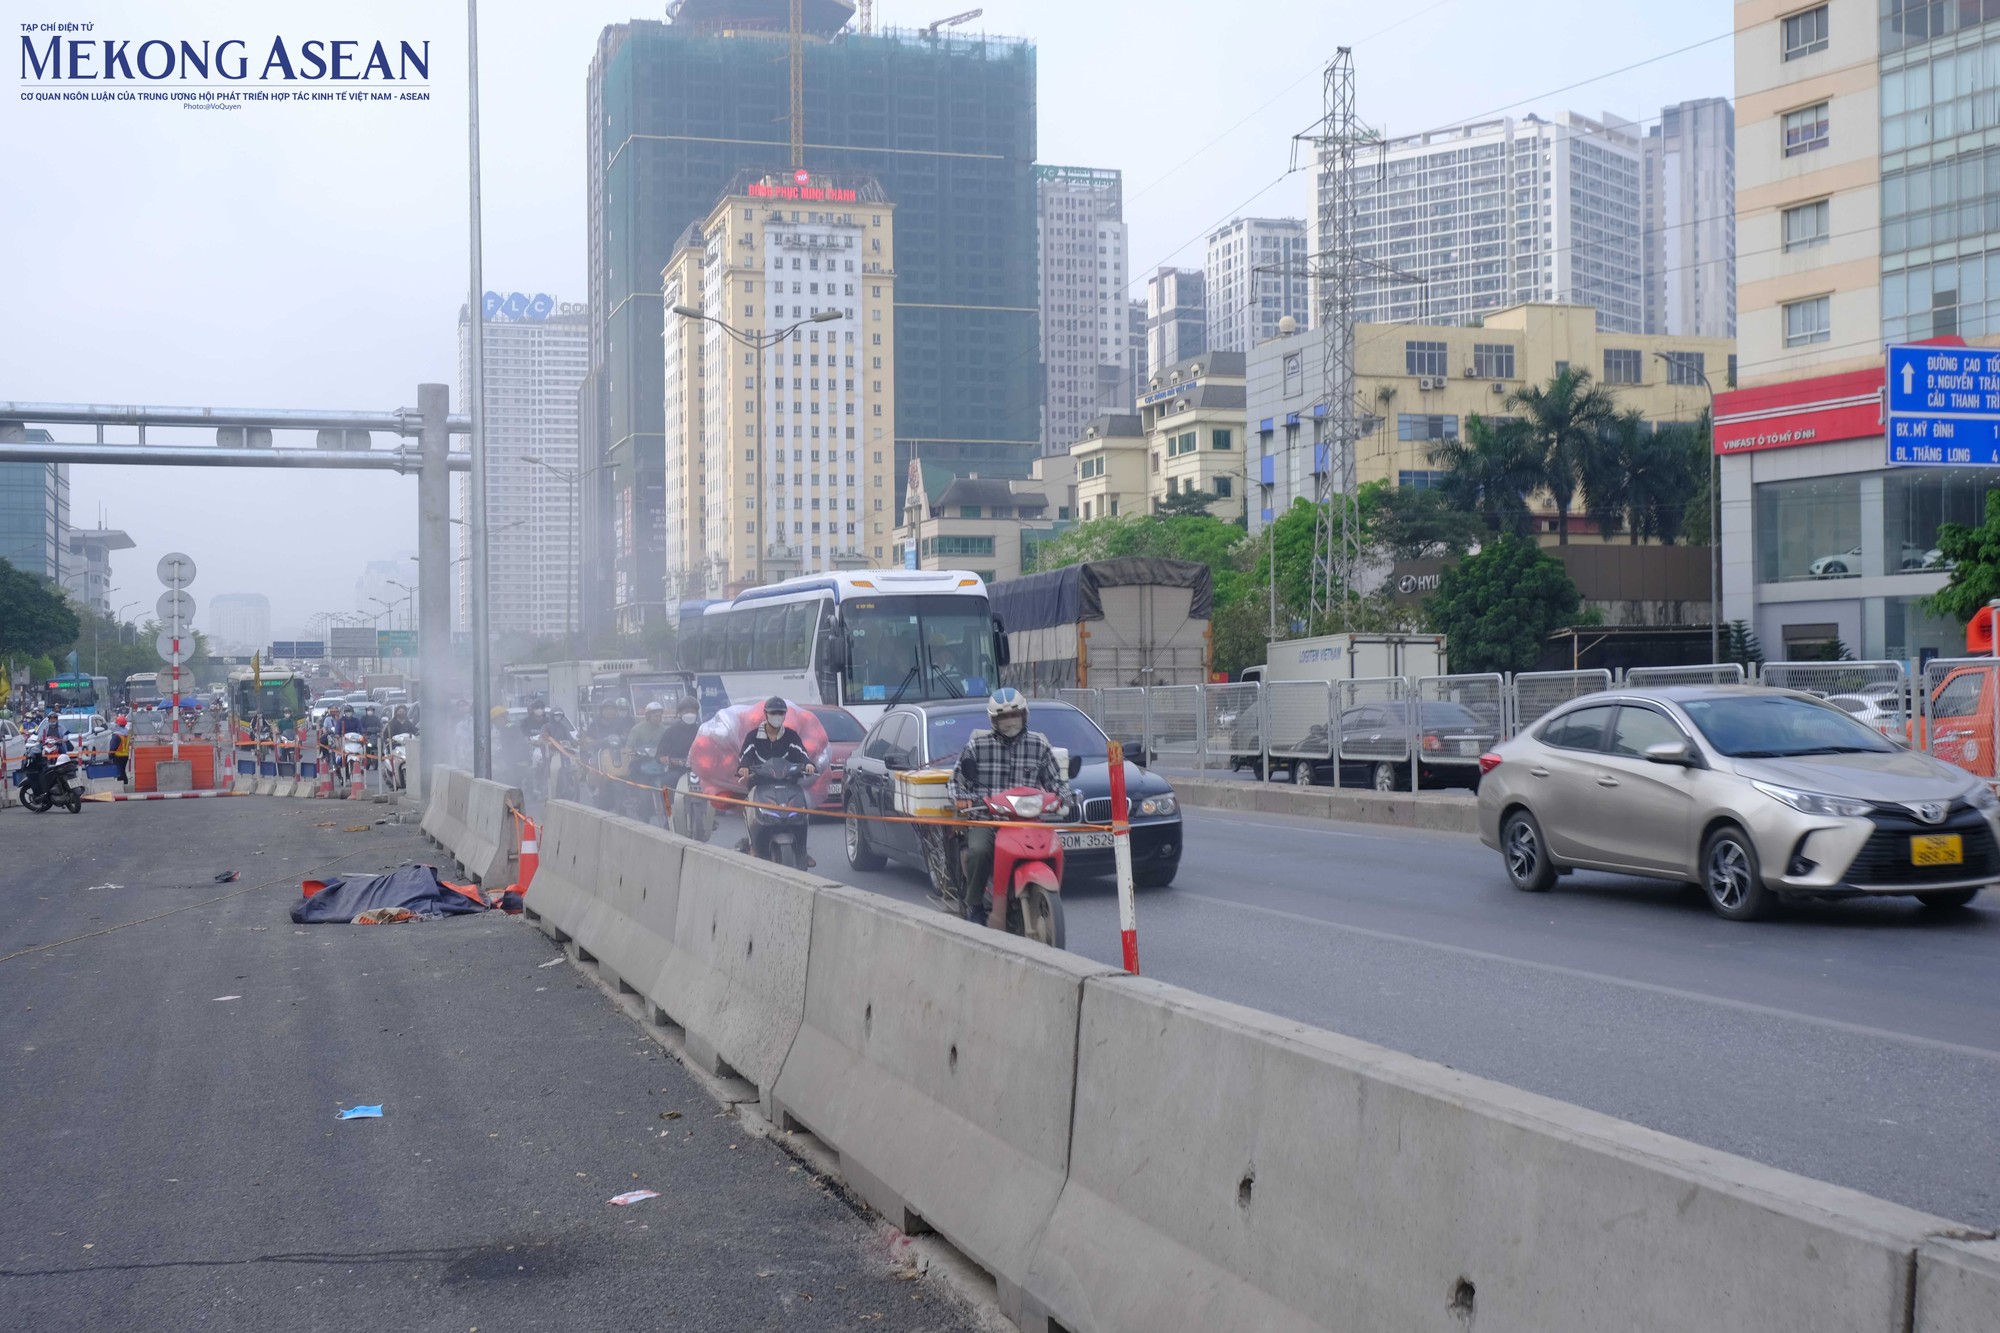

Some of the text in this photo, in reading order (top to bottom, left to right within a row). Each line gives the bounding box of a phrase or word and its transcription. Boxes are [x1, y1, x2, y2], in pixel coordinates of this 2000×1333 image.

[801, 187, 824, 200] MINH
[1927, 352, 1958, 371] ĐƯỜNG
[1963, 358, 1980, 372] CAO
[1979, 375, 2000, 391] TRÃI
[1927, 389, 2000, 409] CẦU THANH TRÌ
[1933, 420, 1954, 438] ĐÌNH
[1723, 436, 1757, 450] VINFAST
[1766, 431, 1779, 444] TÔ
[1947, 447, 1971, 462] LONG
[1991, 449, 1998, 463] 4
[1418, 574, 1441, 590] HYU
